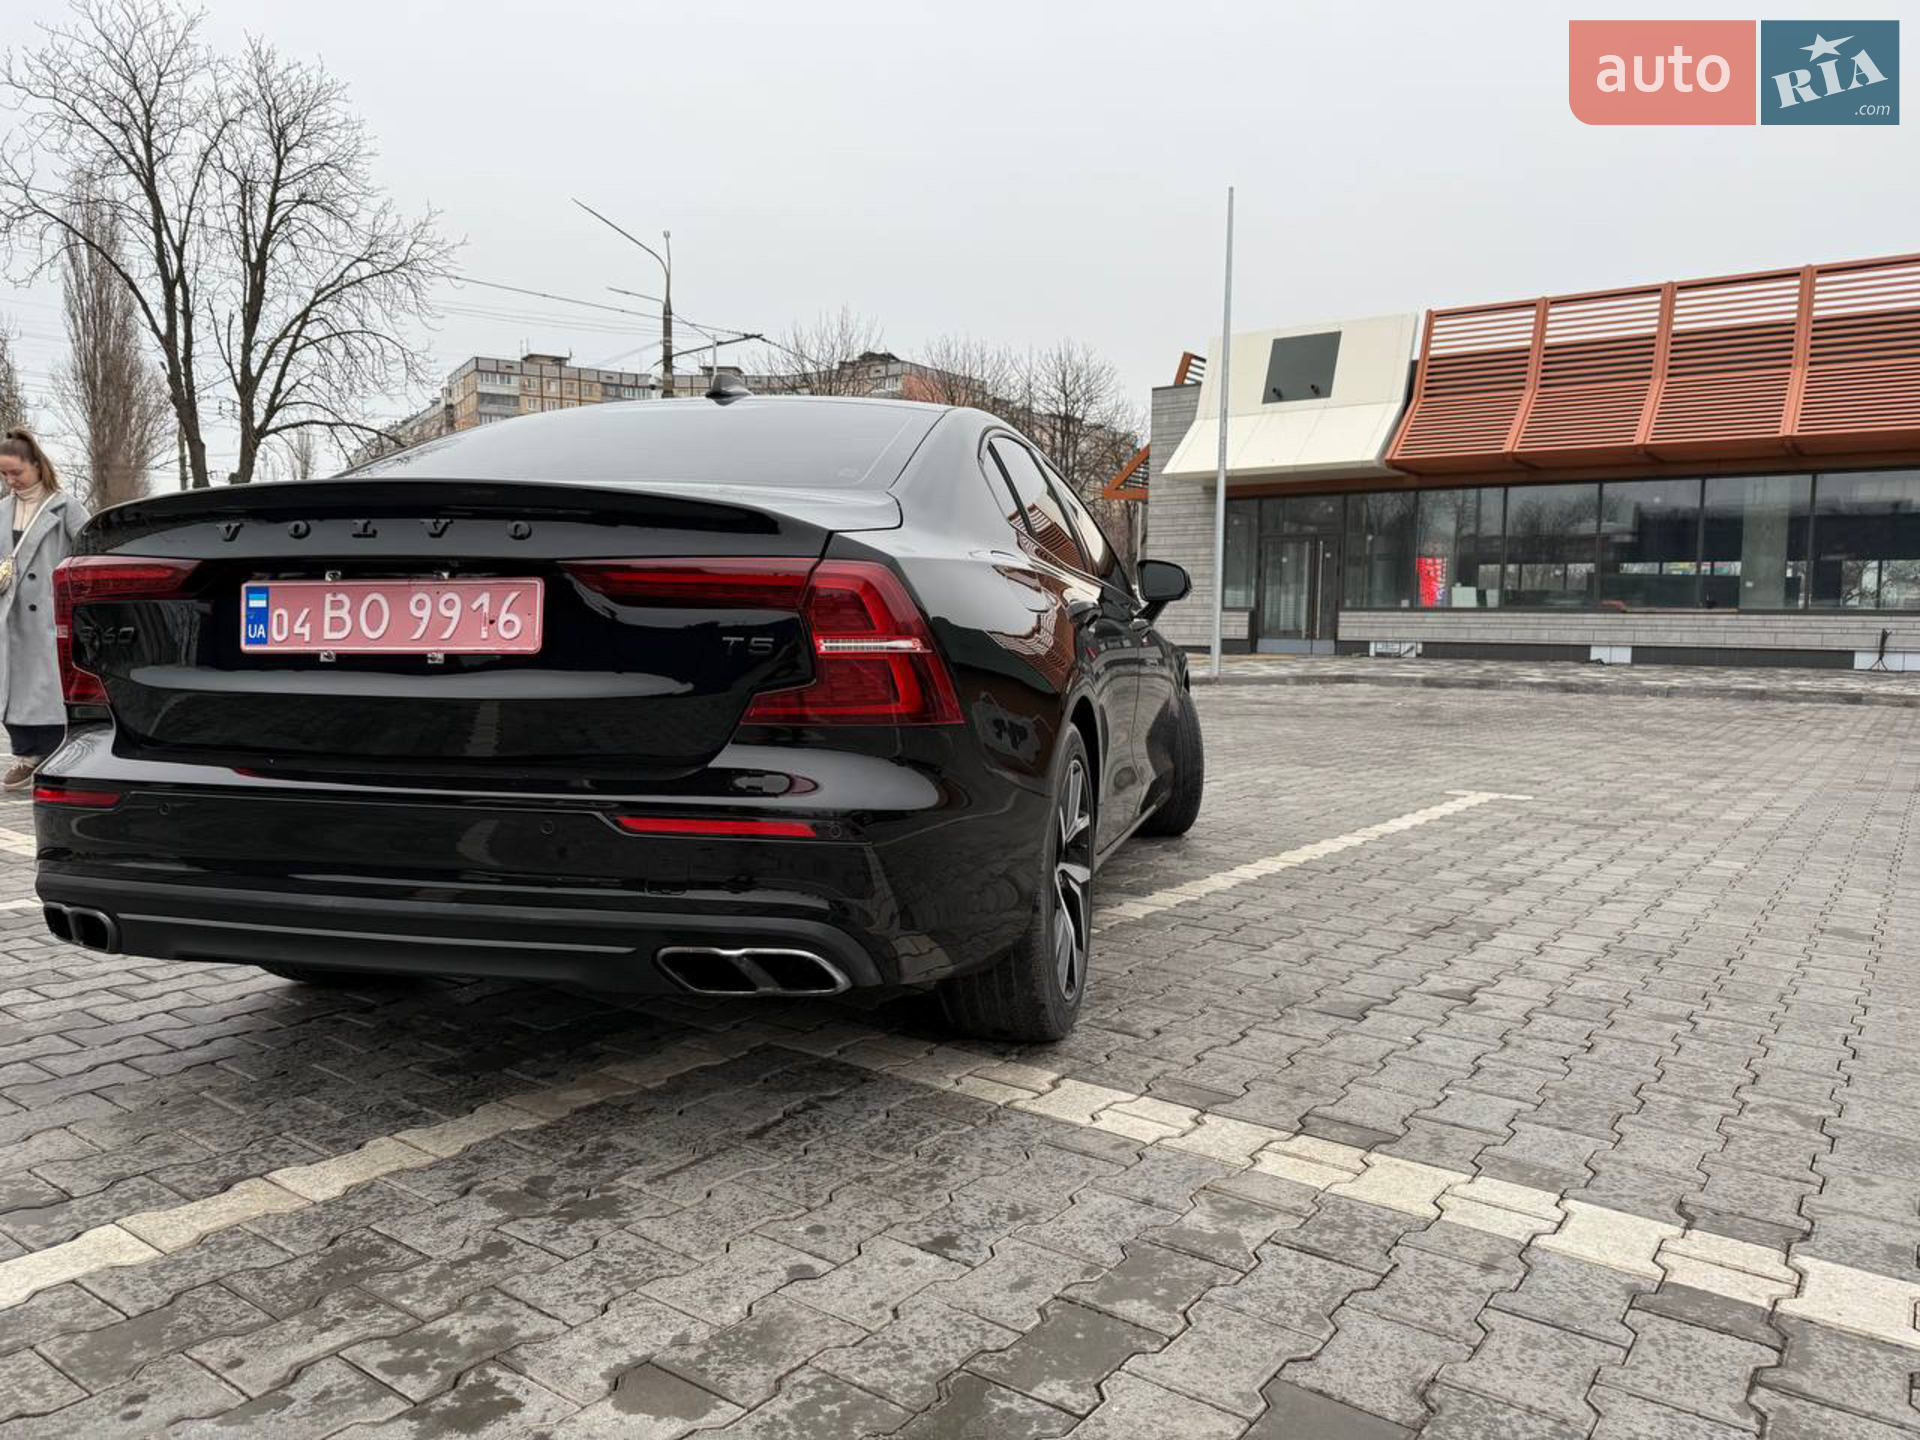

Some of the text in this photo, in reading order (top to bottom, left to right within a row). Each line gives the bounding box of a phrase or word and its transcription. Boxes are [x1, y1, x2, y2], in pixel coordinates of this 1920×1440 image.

[216, 518, 532, 542] VOLVO
[271, 591, 523, 642] 04 BO 9916
[248, 624, 266, 639] UA
[722, 636, 774, 655] T5
